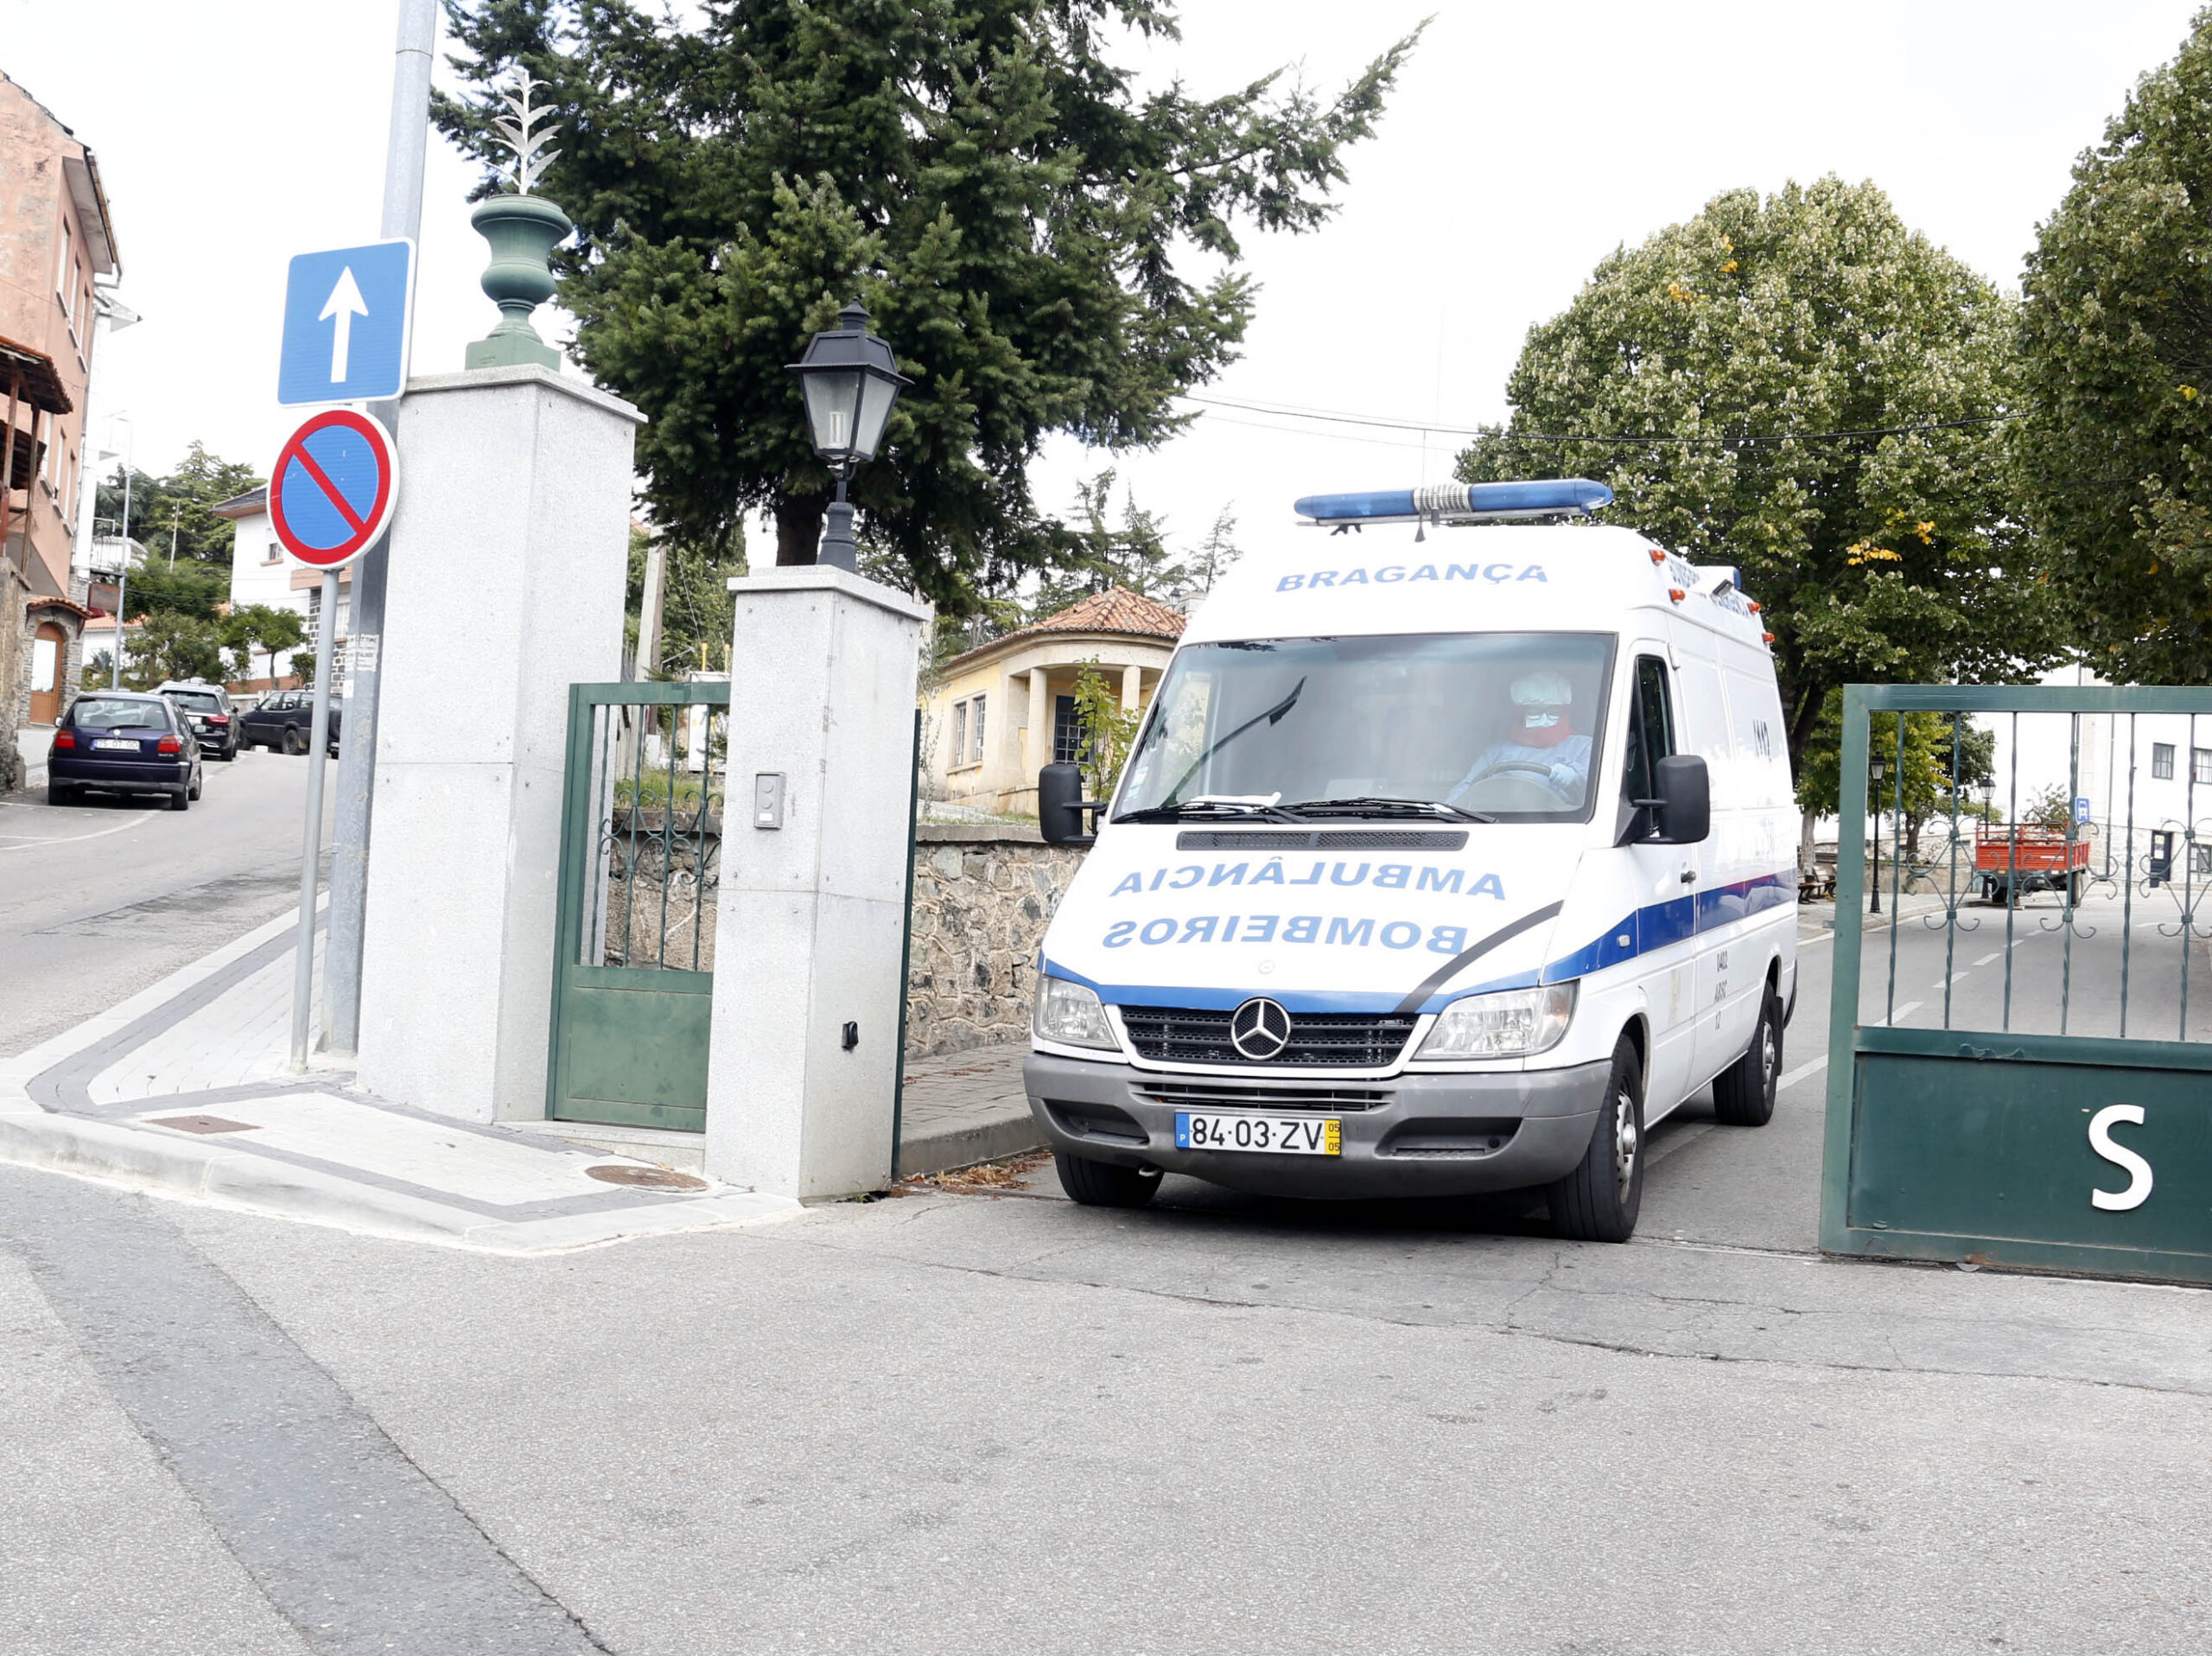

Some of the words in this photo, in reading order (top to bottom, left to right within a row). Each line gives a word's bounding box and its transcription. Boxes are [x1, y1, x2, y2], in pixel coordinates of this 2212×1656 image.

[1275, 564, 1548, 592] BRAGANÇA
[1328, 1123, 1340, 1132] 05
[1328, 1142, 1340, 1152] 05
[2088, 1104, 2153, 1211] S
